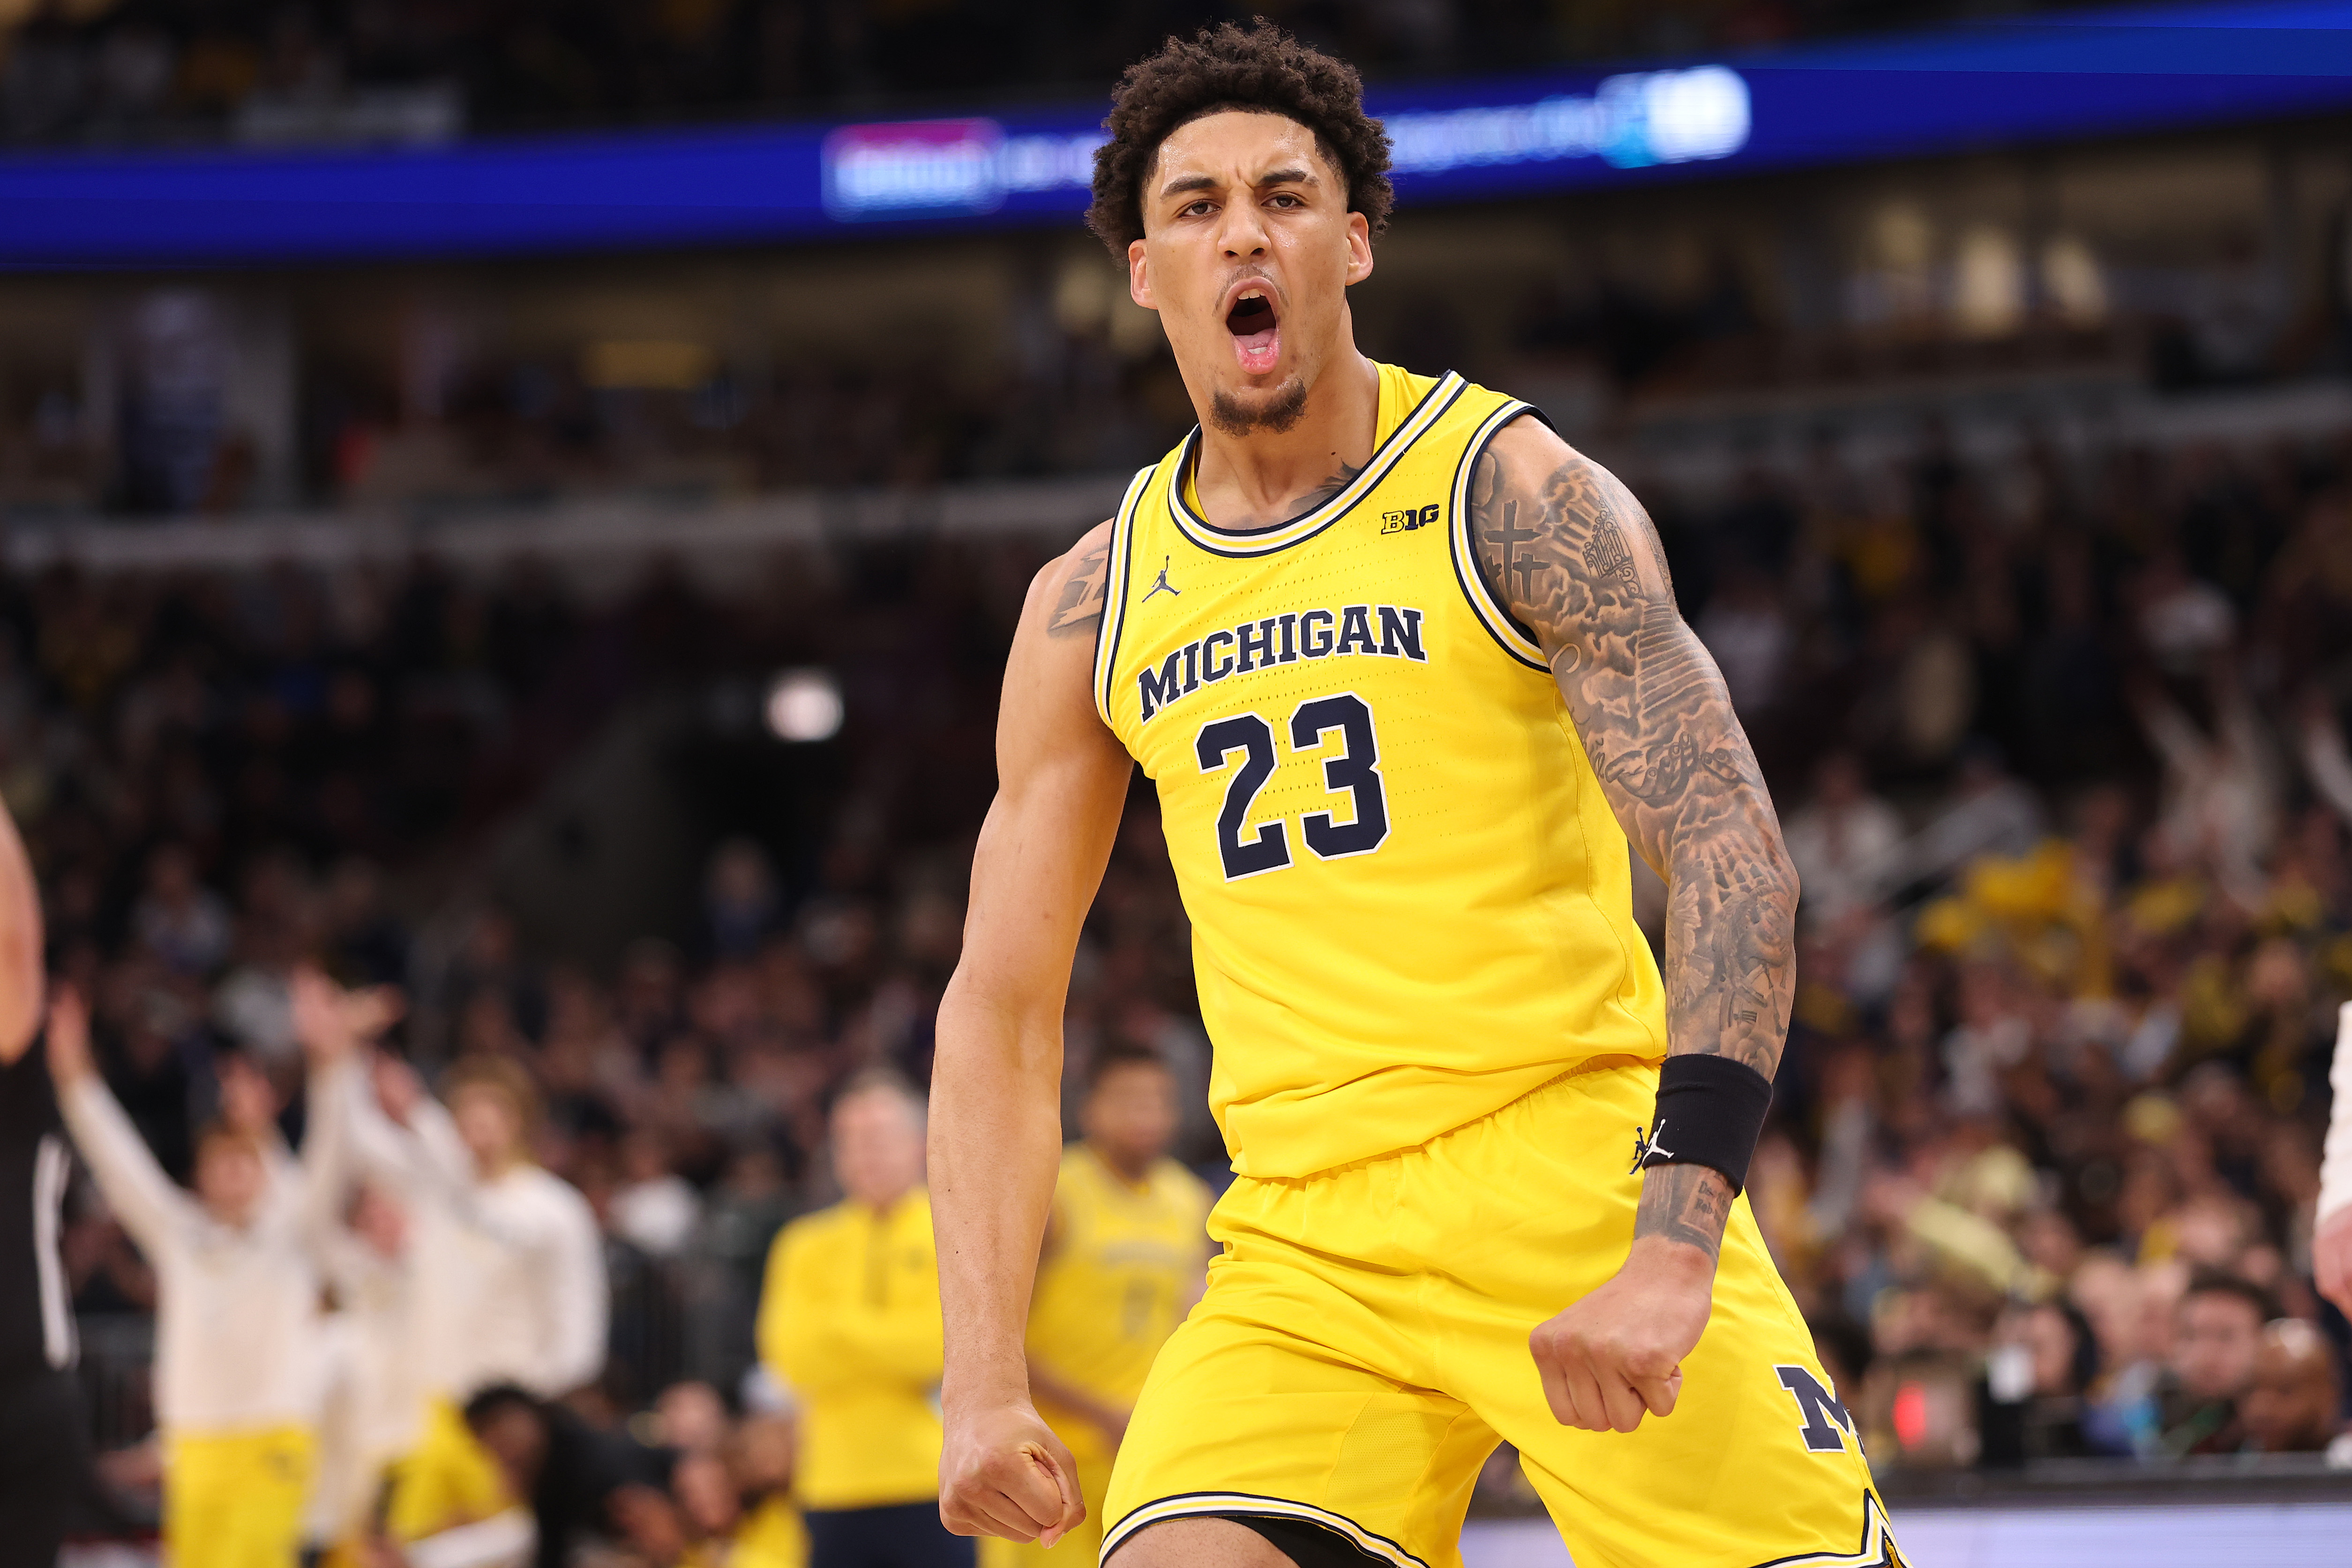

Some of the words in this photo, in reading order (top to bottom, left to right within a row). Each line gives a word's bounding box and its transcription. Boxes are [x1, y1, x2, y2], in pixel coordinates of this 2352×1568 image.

[1137, 604, 1429, 726] MICHIGAN
[1193, 690, 1392, 883] 23
[1772, 1364, 1865, 1457] M
